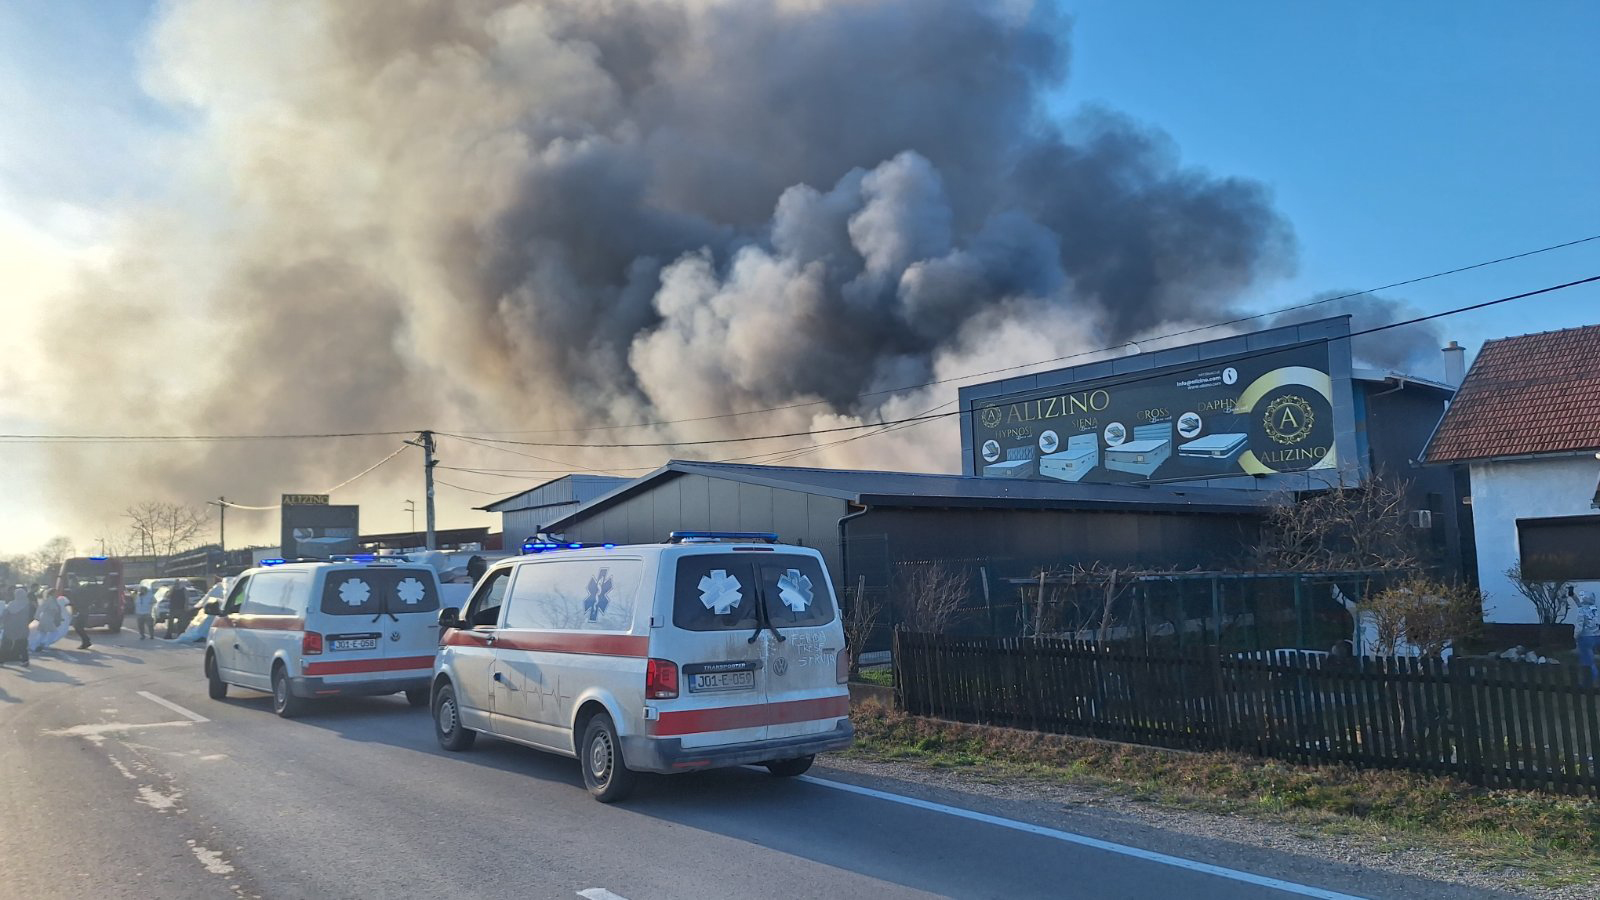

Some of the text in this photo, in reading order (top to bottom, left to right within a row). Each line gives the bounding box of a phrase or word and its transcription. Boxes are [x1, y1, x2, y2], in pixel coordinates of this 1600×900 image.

[1007, 389, 1110, 423] ALIZINO
[1197, 396, 1241, 412] DAPHN
[987, 409, 996, 421] A
[1279, 407, 1300, 430] A
[1071, 417, 1098, 430] SIENA
[1260, 446, 1327, 464] ALIZINO
[703, 663, 746, 671] TRANSPORTER
[697, 672, 753, 688] J01-E-059
